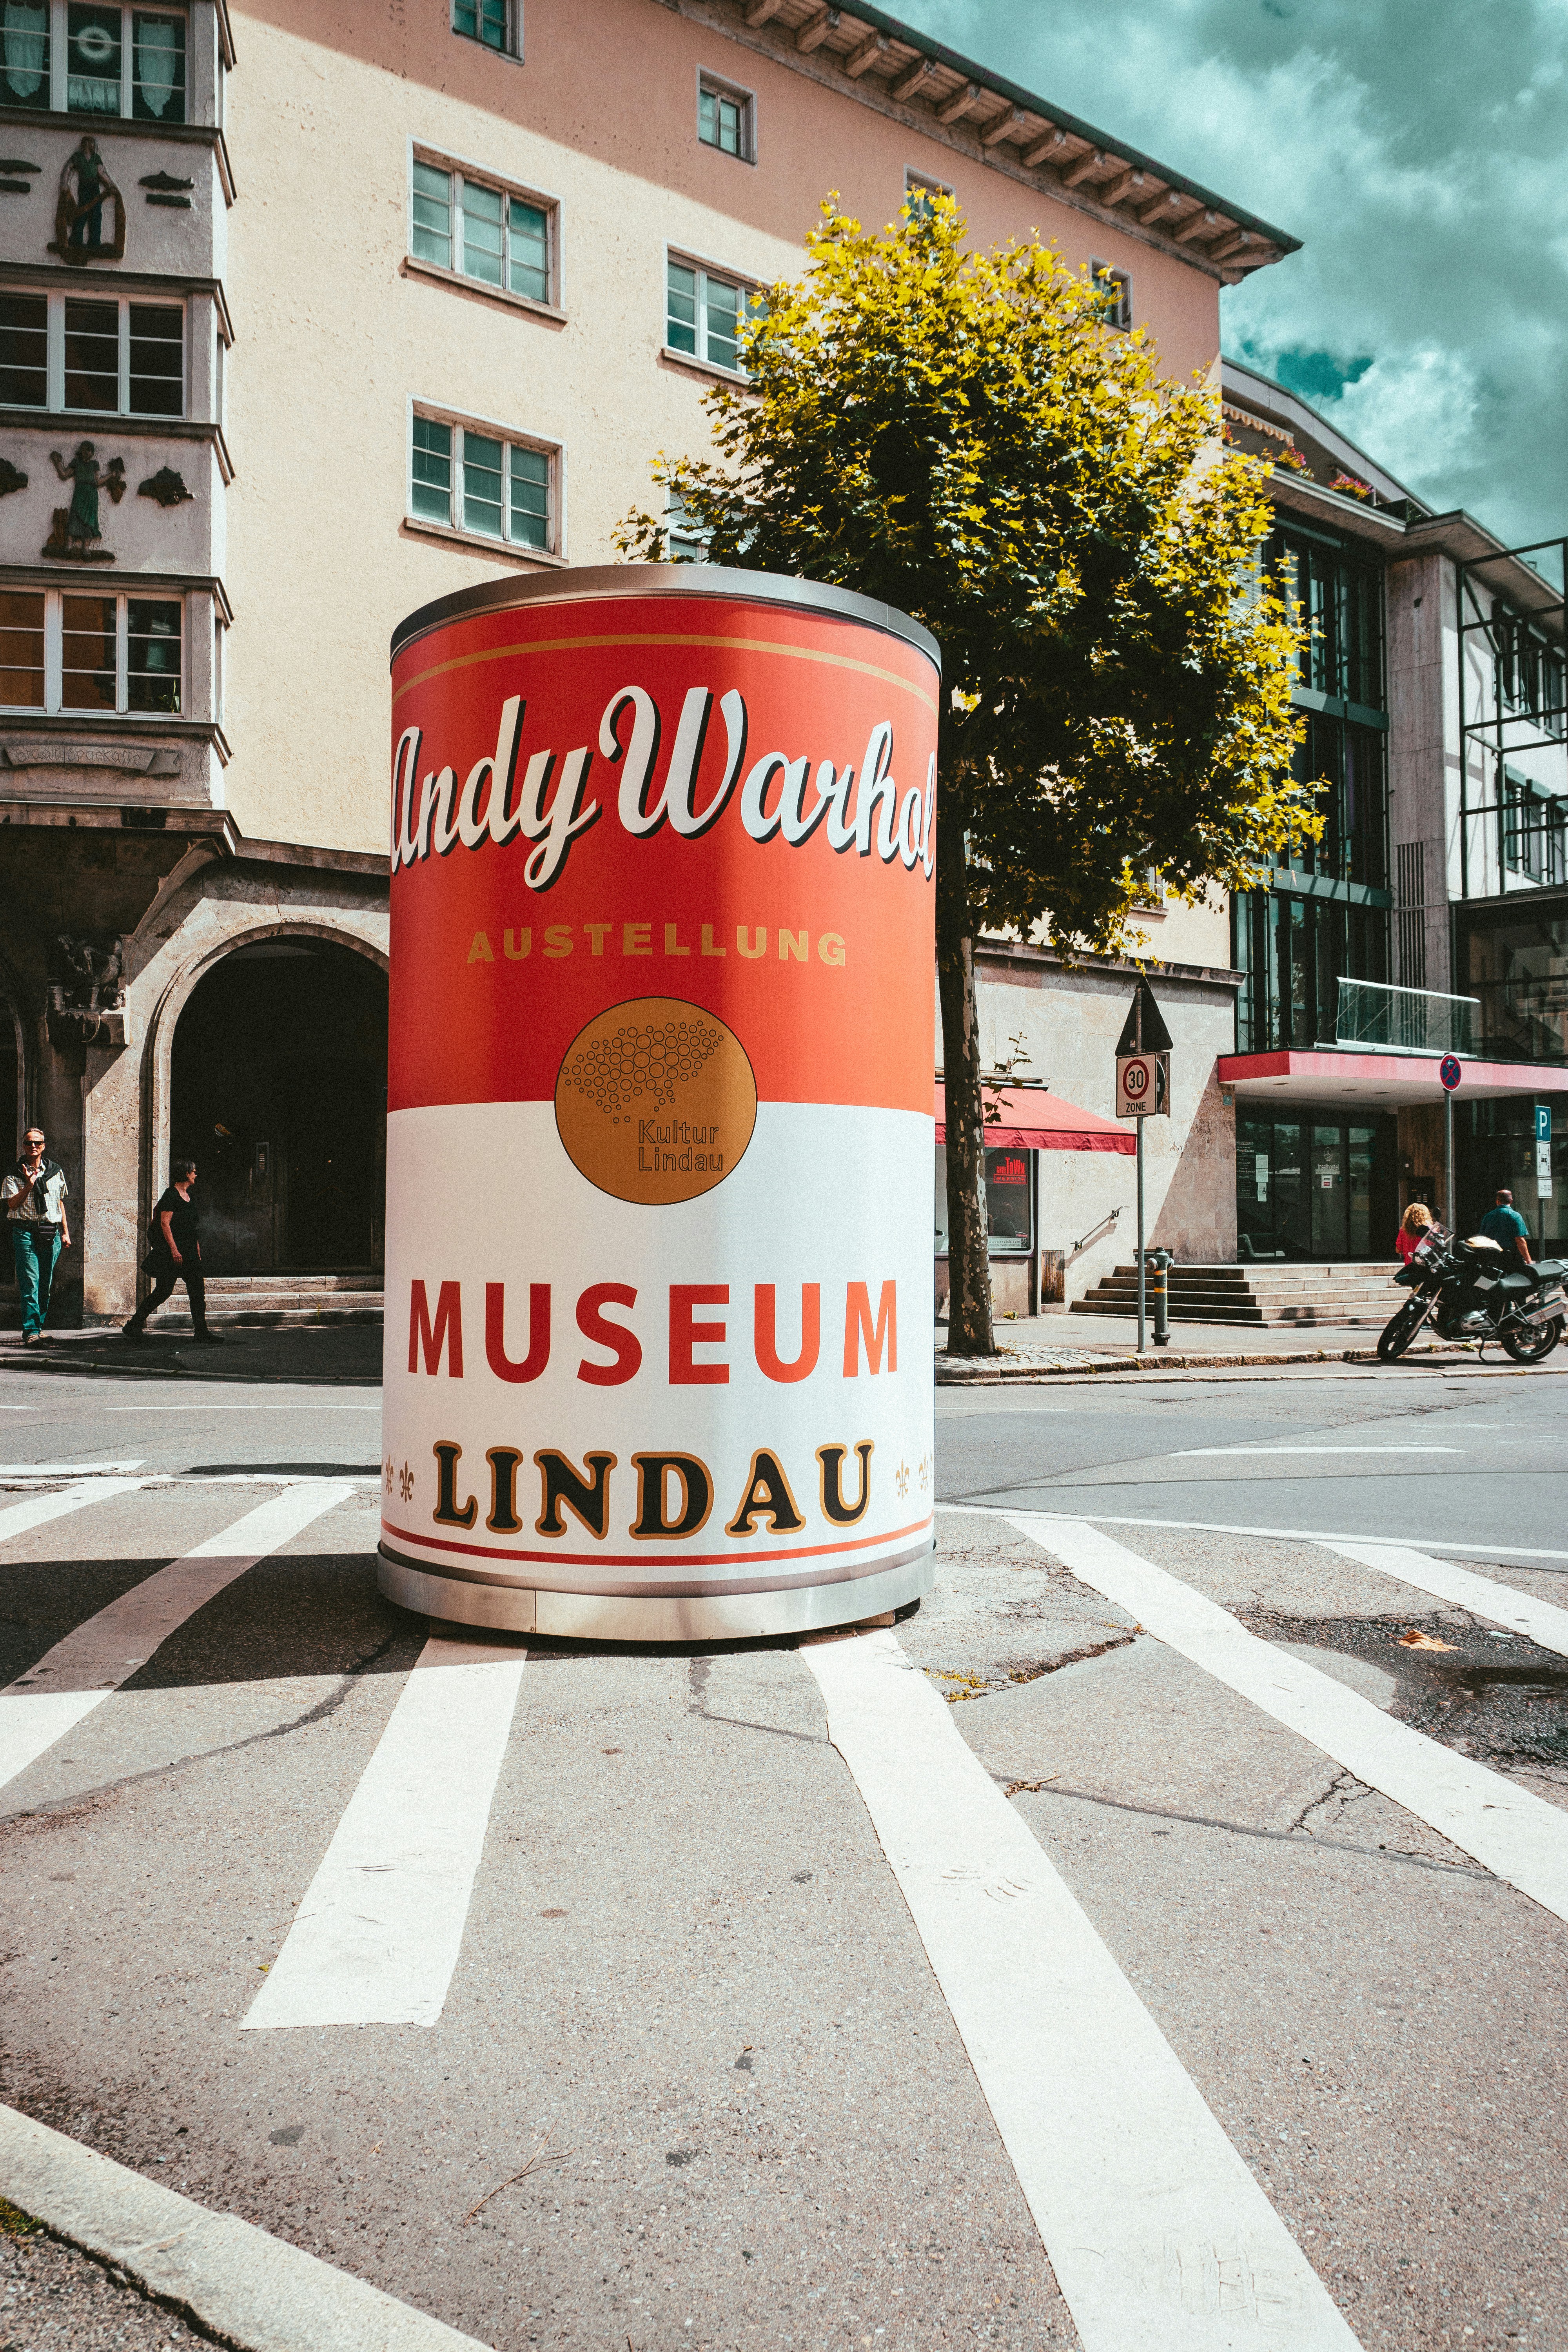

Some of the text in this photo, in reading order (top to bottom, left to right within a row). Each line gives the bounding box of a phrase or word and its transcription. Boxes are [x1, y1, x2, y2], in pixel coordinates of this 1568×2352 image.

[391, 686, 936, 893] Andy Warhol
[467, 923, 846, 966] AUSTELLUNG
[1128, 1070, 1144, 1089] 30
[1126, 1102, 1146, 1112] ZONE
[639, 1120, 720, 1144] Kultur
[1540, 1111, 1548, 1136] P
[639, 1147, 724, 1172] Lindau
[408, 1280, 897, 1386] MUSEUM
[433, 1439, 875, 1540] LINDAU
